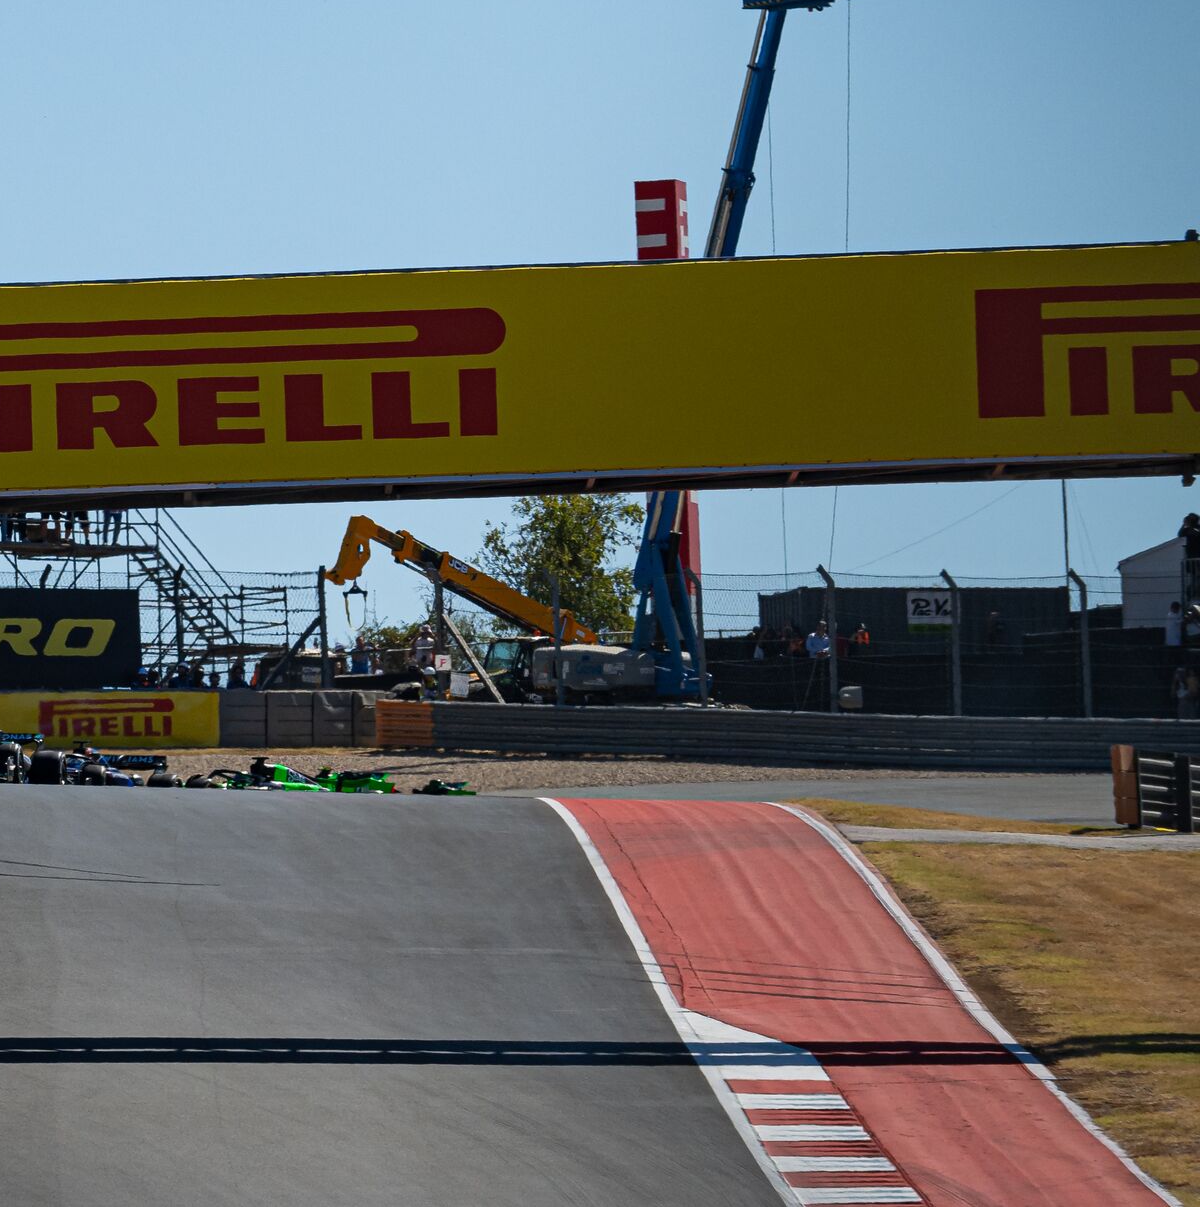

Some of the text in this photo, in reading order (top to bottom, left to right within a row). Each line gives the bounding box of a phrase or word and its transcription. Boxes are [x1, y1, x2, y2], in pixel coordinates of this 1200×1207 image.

[448, 558, 469, 574] JCB
[39, 698, 174, 738] PIRELLI
[99, 755, 154, 764] WIIAMS
